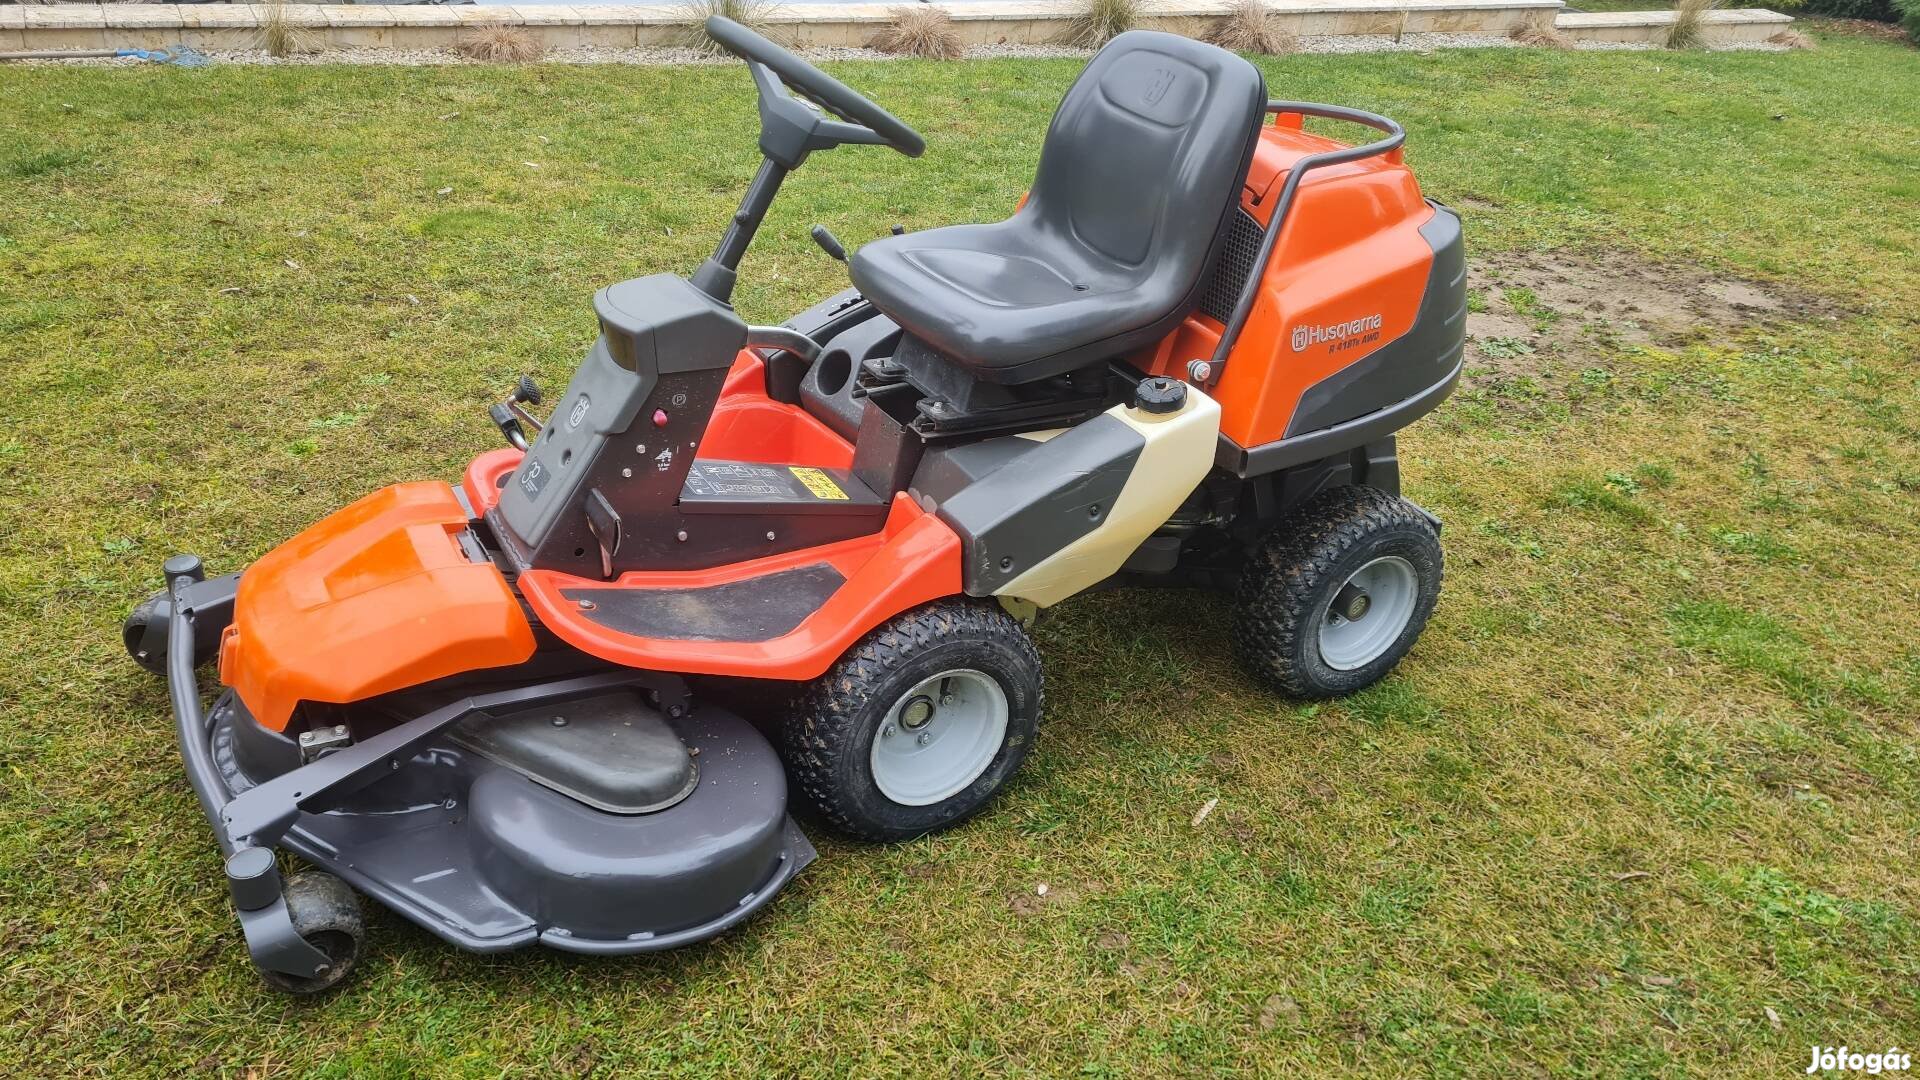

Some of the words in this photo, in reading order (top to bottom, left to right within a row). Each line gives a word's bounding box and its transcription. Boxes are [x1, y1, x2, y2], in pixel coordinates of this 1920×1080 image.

[1309, 313, 1382, 344] Husqvarna
[1329, 344, 1335, 354] R
[1362, 332, 1380, 345] AWD
